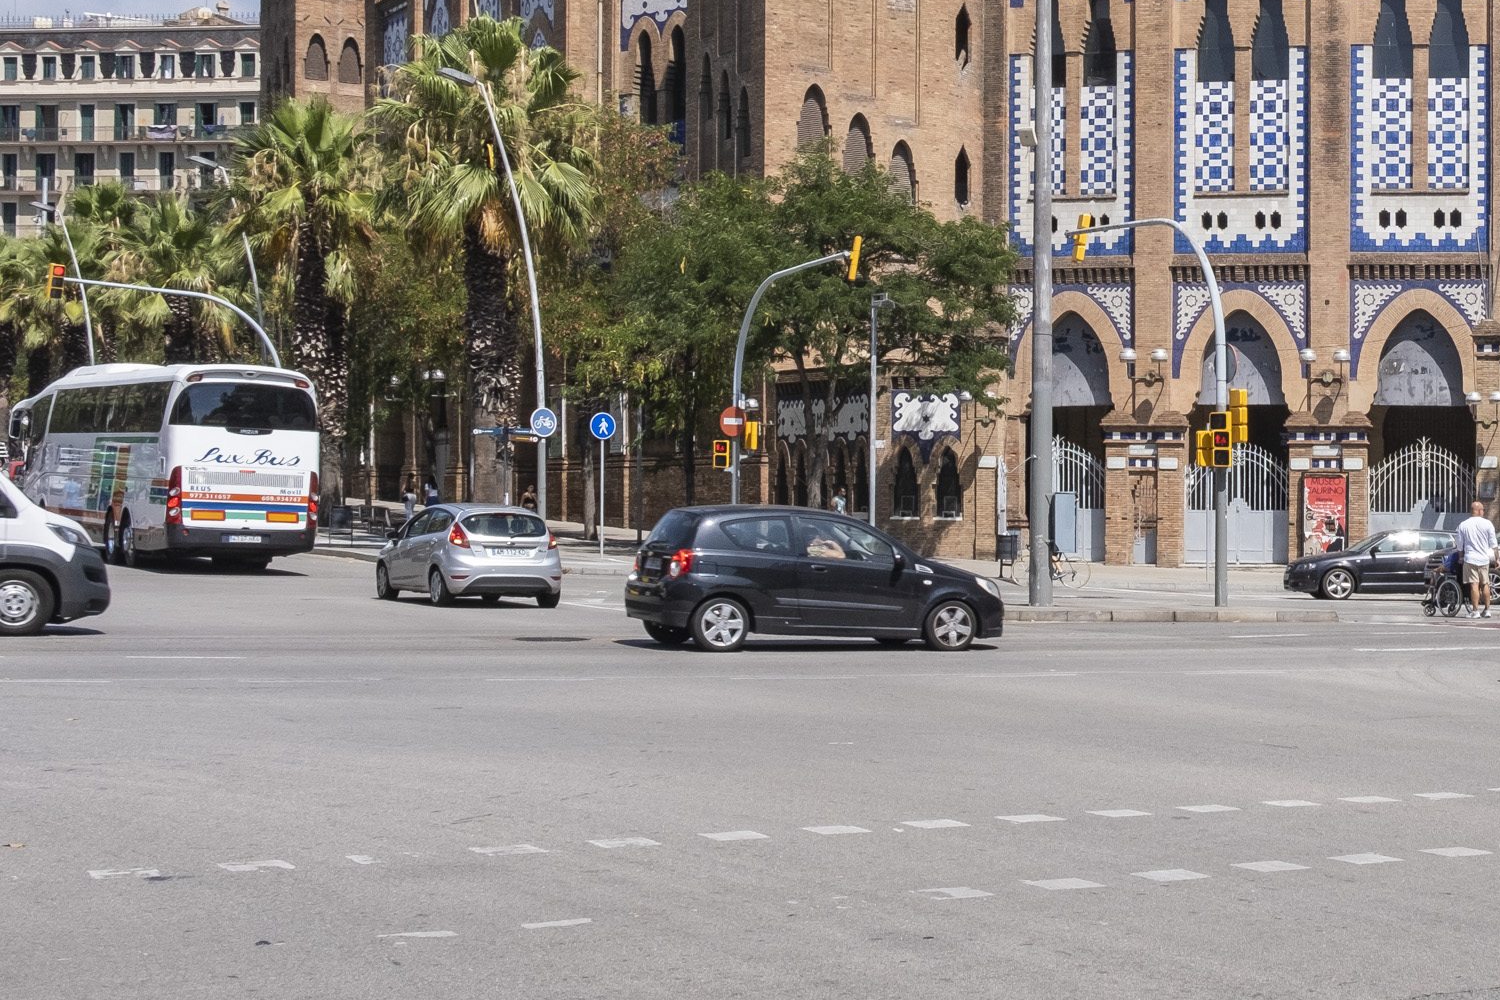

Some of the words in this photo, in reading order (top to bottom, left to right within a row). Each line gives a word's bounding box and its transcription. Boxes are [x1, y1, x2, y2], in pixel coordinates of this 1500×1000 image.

[194, 447, 245, 465] Lux
[246, 449, 301, 467] Bus
[1310, 477, 1341, 486] MUSEO
